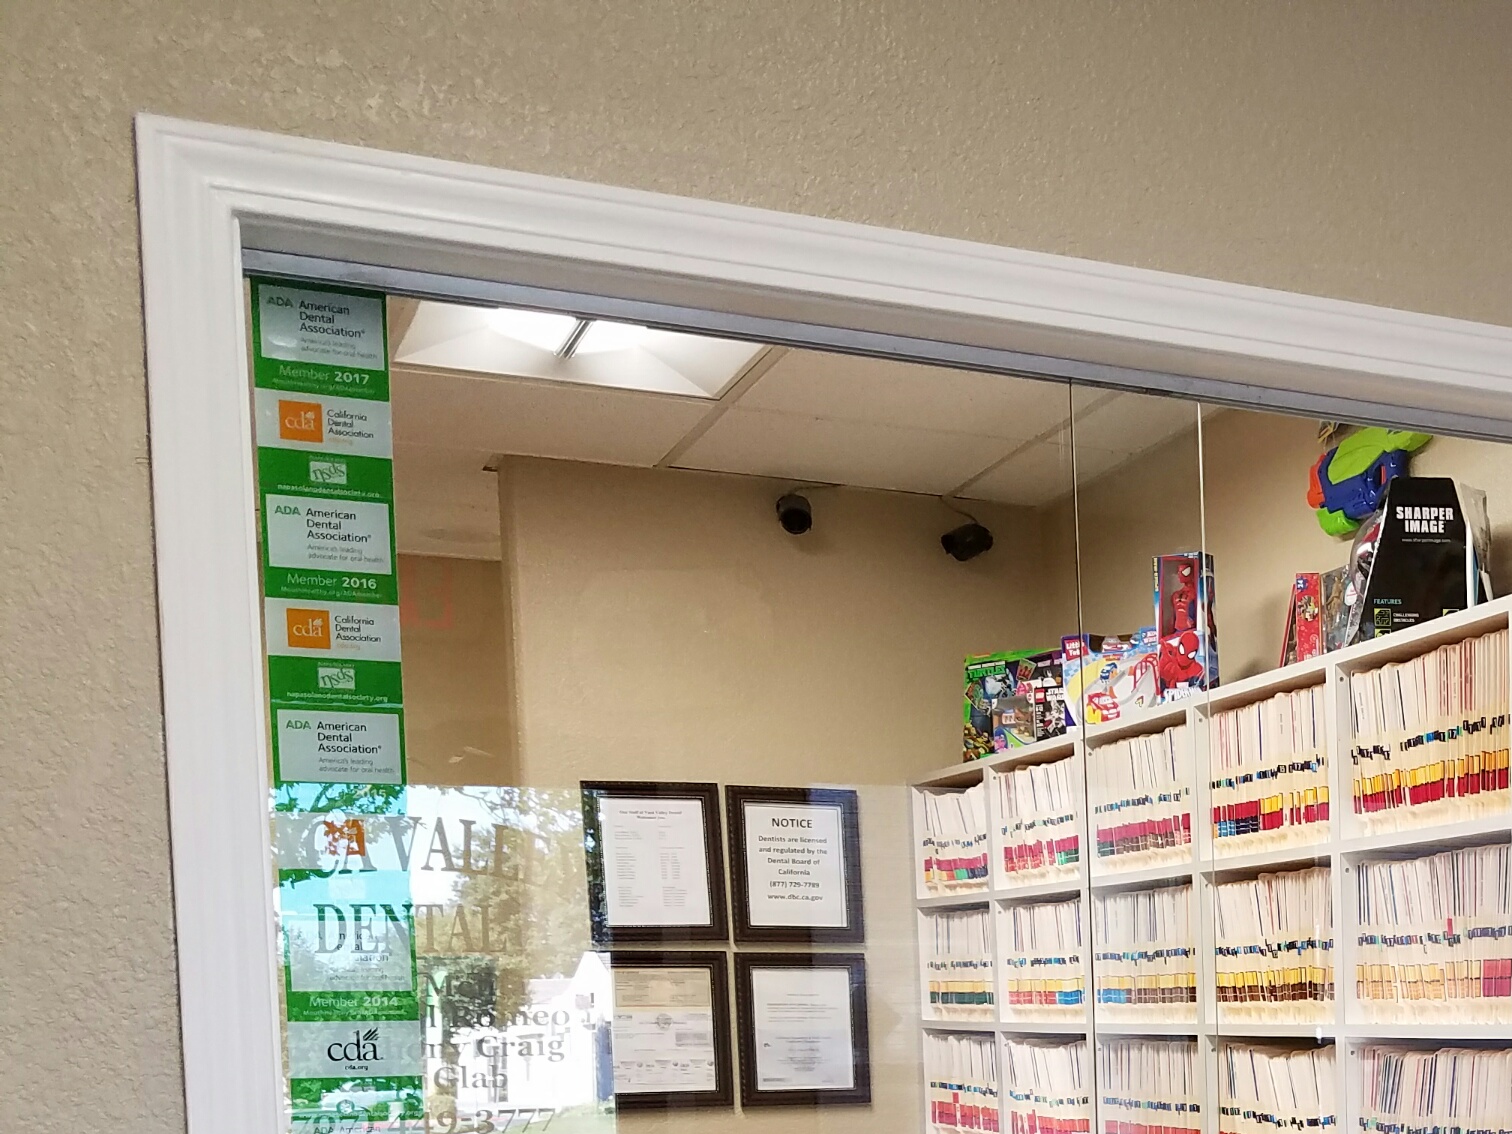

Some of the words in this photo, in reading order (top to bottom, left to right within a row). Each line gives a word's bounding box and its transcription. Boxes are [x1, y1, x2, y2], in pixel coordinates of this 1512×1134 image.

[266, 296, 294, 308] ADA
[299, 300, 350, 315] American
[299, 311, 335, 324] Dental
[280, 364, 330, 380] Member
[334, 371, 370, 385] 2017
[327, 409, 367, 422] California
[327, 418, 354, 428] Dental
[328, 427, 374, 439] Association
[274, 505, 301, 516] ADA
[306, 508, 356, 520] American
[1396, 506, 1454, 520] SHARPER
[306, 518, 342, 530] Dental
[1404, 520, 1445, 534] IMAGE
[287, 573, 338, 586] Member
[342, 577, 377, 590] 2016
[334, 615, 375, 626] California
[293, 618, 322, 637] cda
[335, 624, 361, 633] Dental
[335, 633, 382, 643] Association
[285, 719, 312, 730] ADA
[316, 721, 367, 732] American
[317, 732, 353, 743] Dental
[771, 817, 813, 829] NOTICE
[772, 847, 806, 855] regulated
[767, 857, 790, 865] Dental
[778, 868, 811, 876] California
[769, 881, 788, 889] (877)
[767, 893, 823, 901] www.dbc.ca.gov
[313, 903, 507, 956] DENTAL
[309, 995, 360, 1008] Member
[363, 996, 399, 1007] 2014
[327, 1029, 381, 1062] cda
